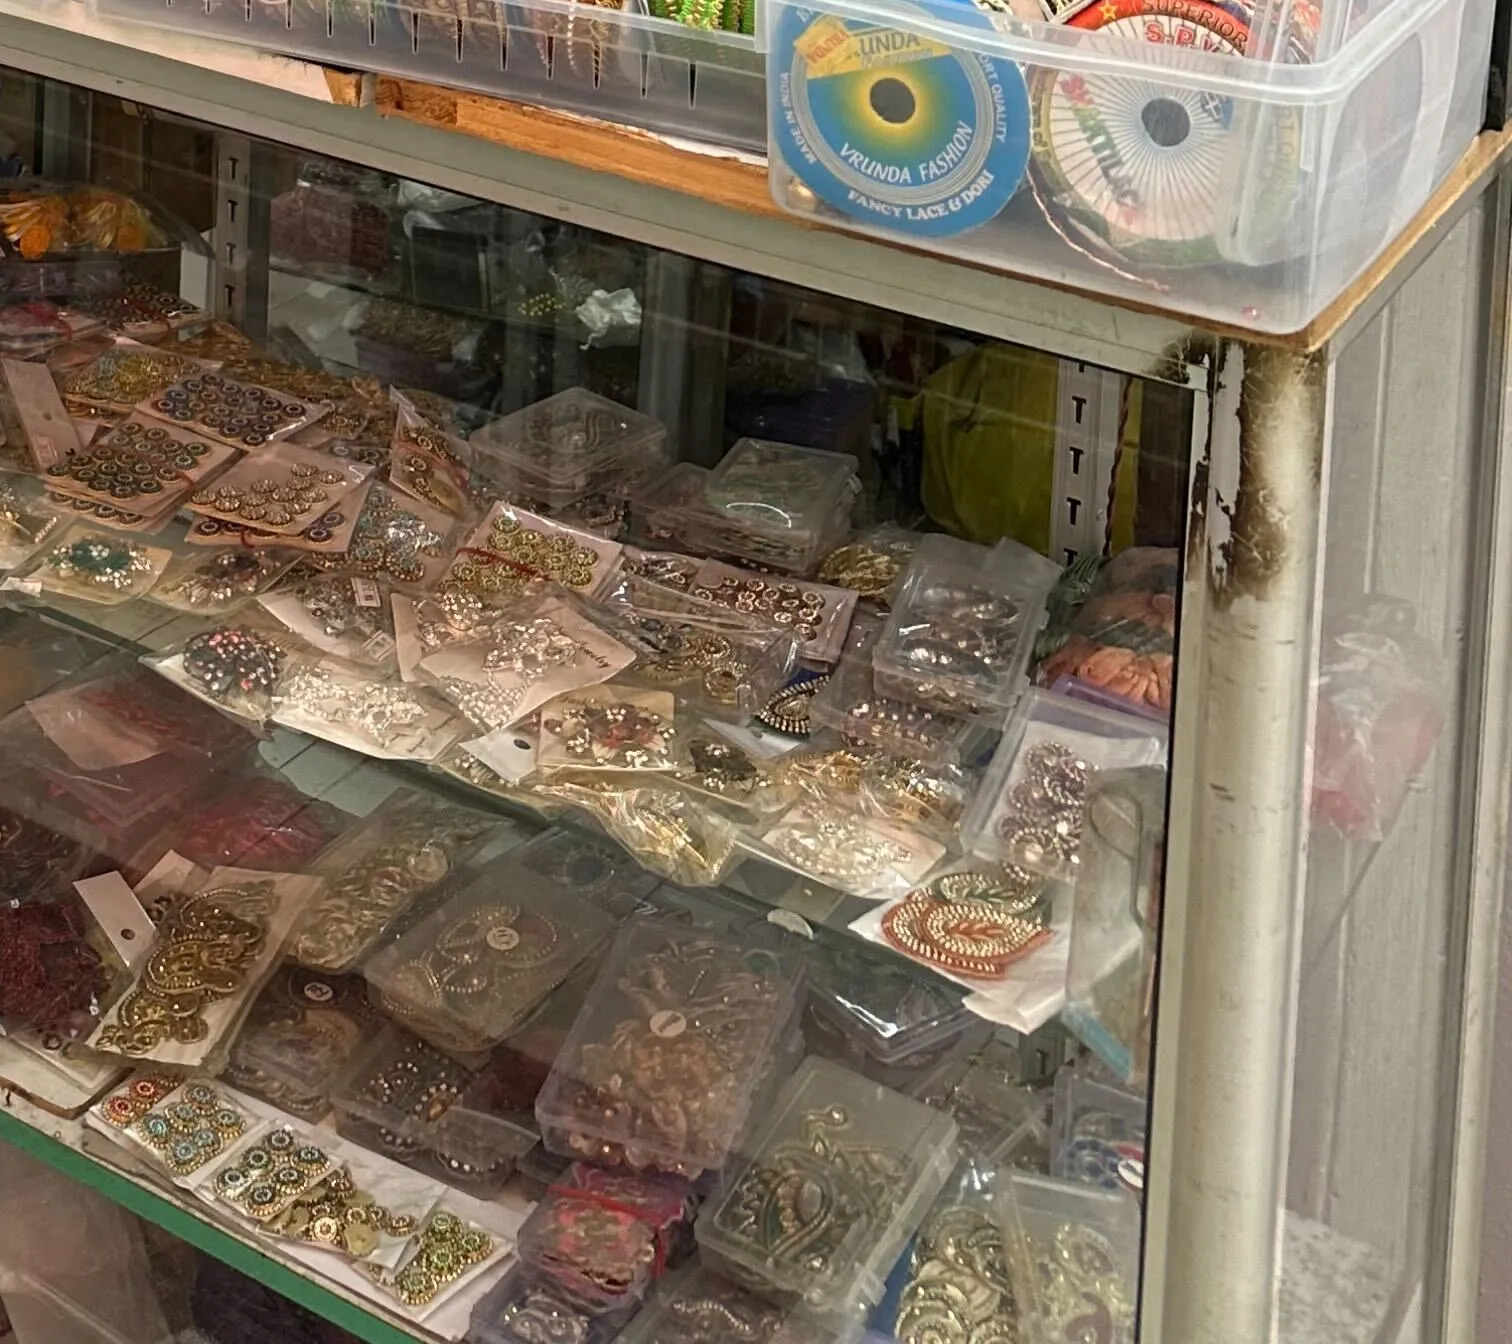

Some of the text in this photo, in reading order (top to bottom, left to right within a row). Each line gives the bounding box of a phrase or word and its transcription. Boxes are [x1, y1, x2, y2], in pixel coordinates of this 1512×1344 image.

[779, 71, 818, 165] MADE IN INDIA
[989, 83, 1008, 144] QUALITY
[839, 120, 974, 184] VRUNDA FASHION
[846, 189, 903, 220] FANCY
[905, 201, 950, 221] LACE
[961, 171, 996, 206] DORI
